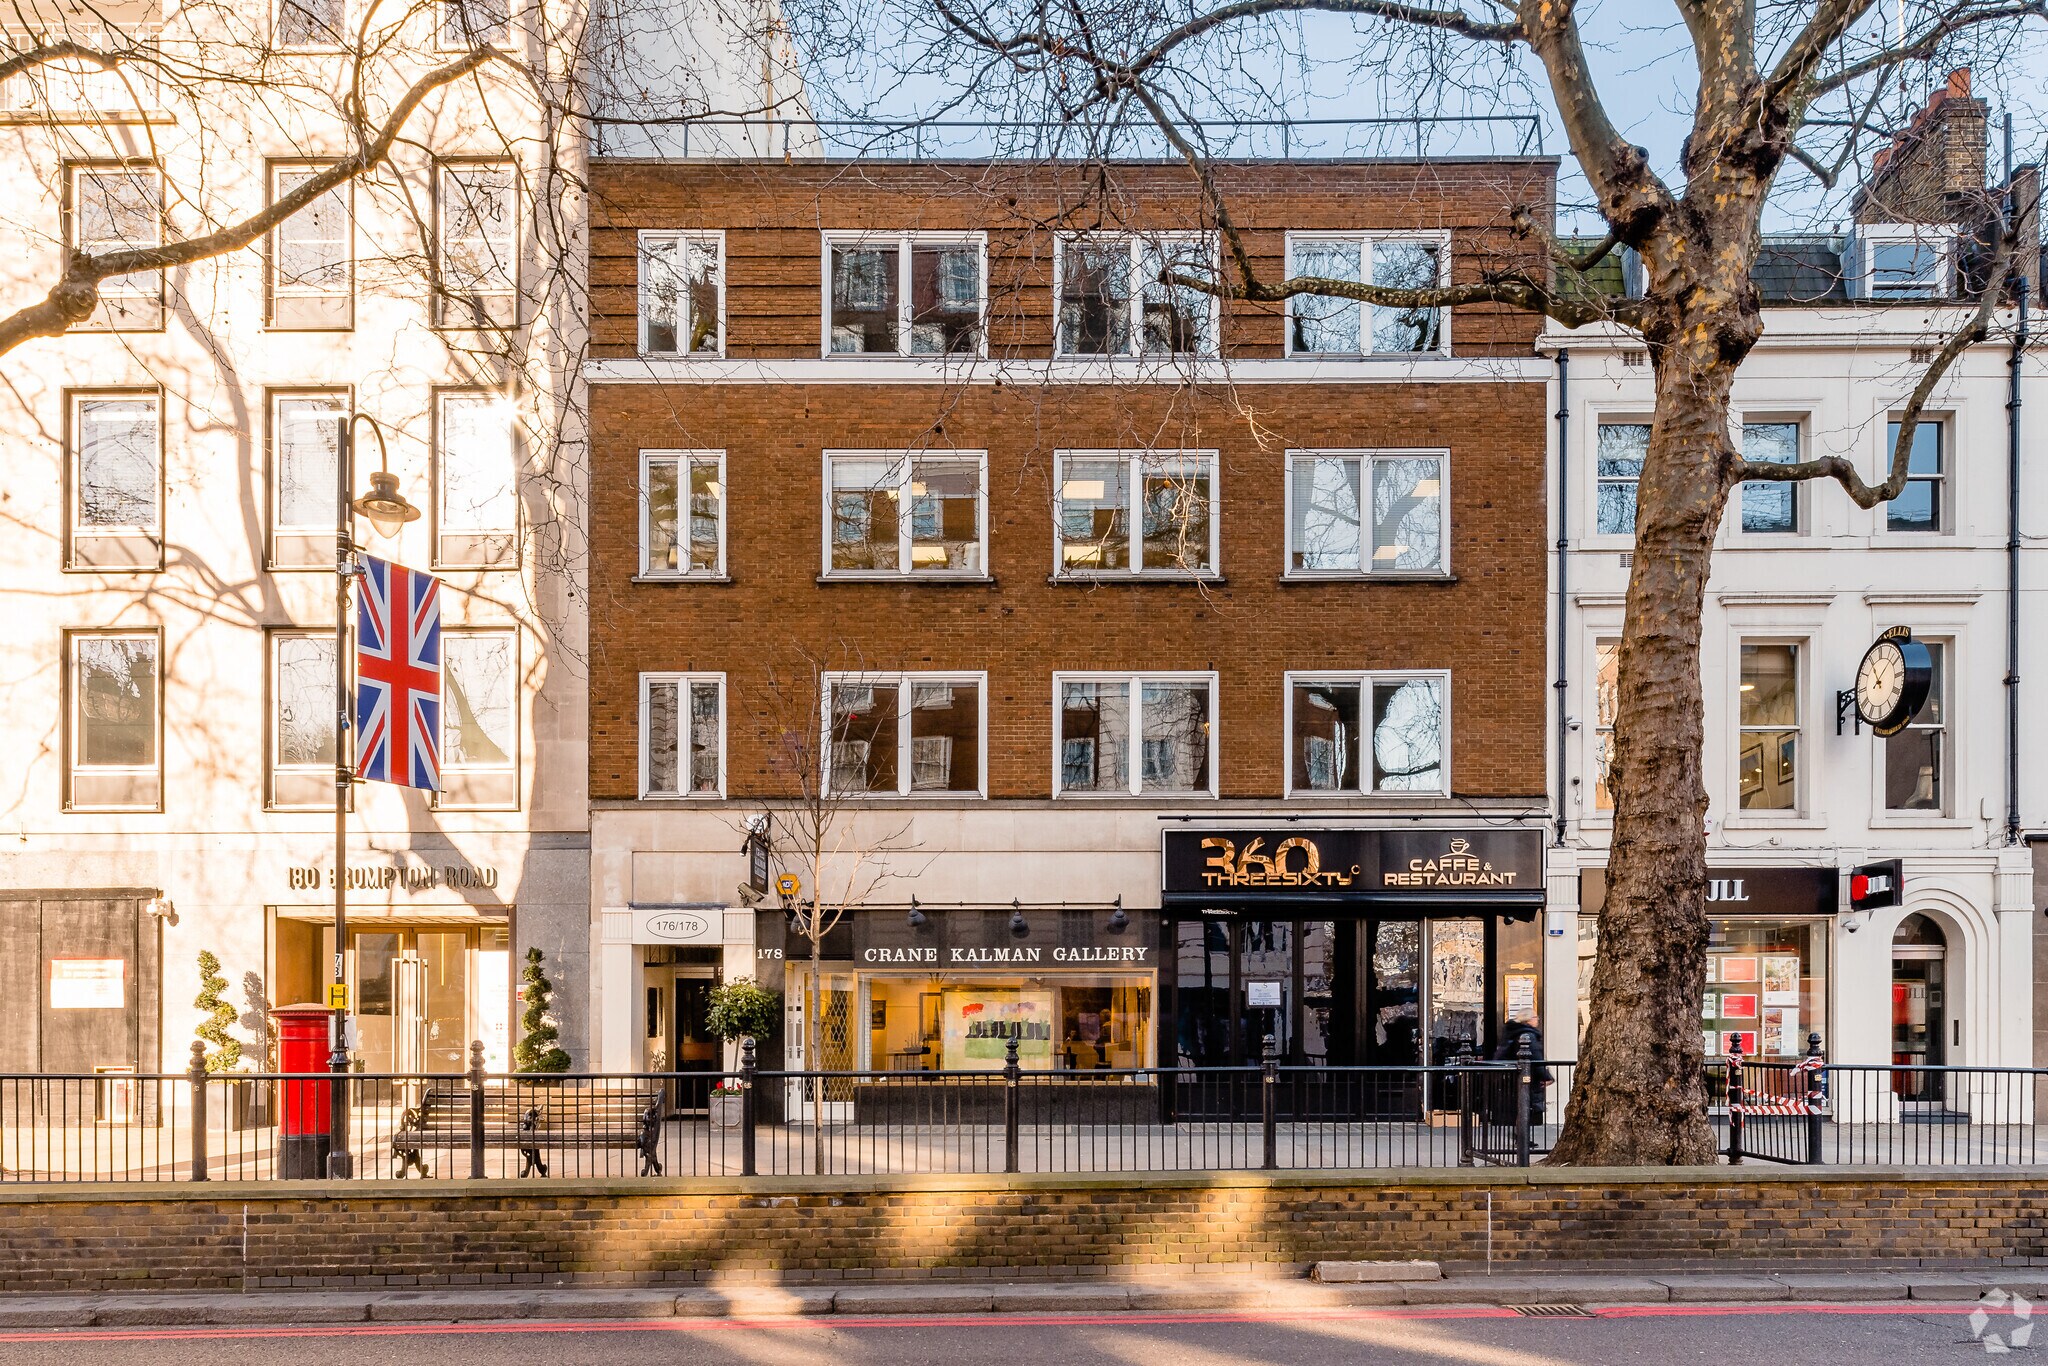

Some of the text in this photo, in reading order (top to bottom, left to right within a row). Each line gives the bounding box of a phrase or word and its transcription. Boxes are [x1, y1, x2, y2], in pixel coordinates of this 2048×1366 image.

[1201, 837, 1320, 873] 360
[1409, 858, 1493, 871] CAFFE &
[286, 866, 320, 890] 180
[444, 866, 498, 890] ROAD
[1384, 872, 1517, 886] RESTAURANT
[1865, 875, 1890, 894] JLL
[1706, 879, 1750, 902] JLL
[656, 921, 699, 931] 176/178
[757, 948, 783, 959] 178
[864, 947, 1149, 962] CRANE KALMAN GALLERY
[331, 987, 346, 1006] H
